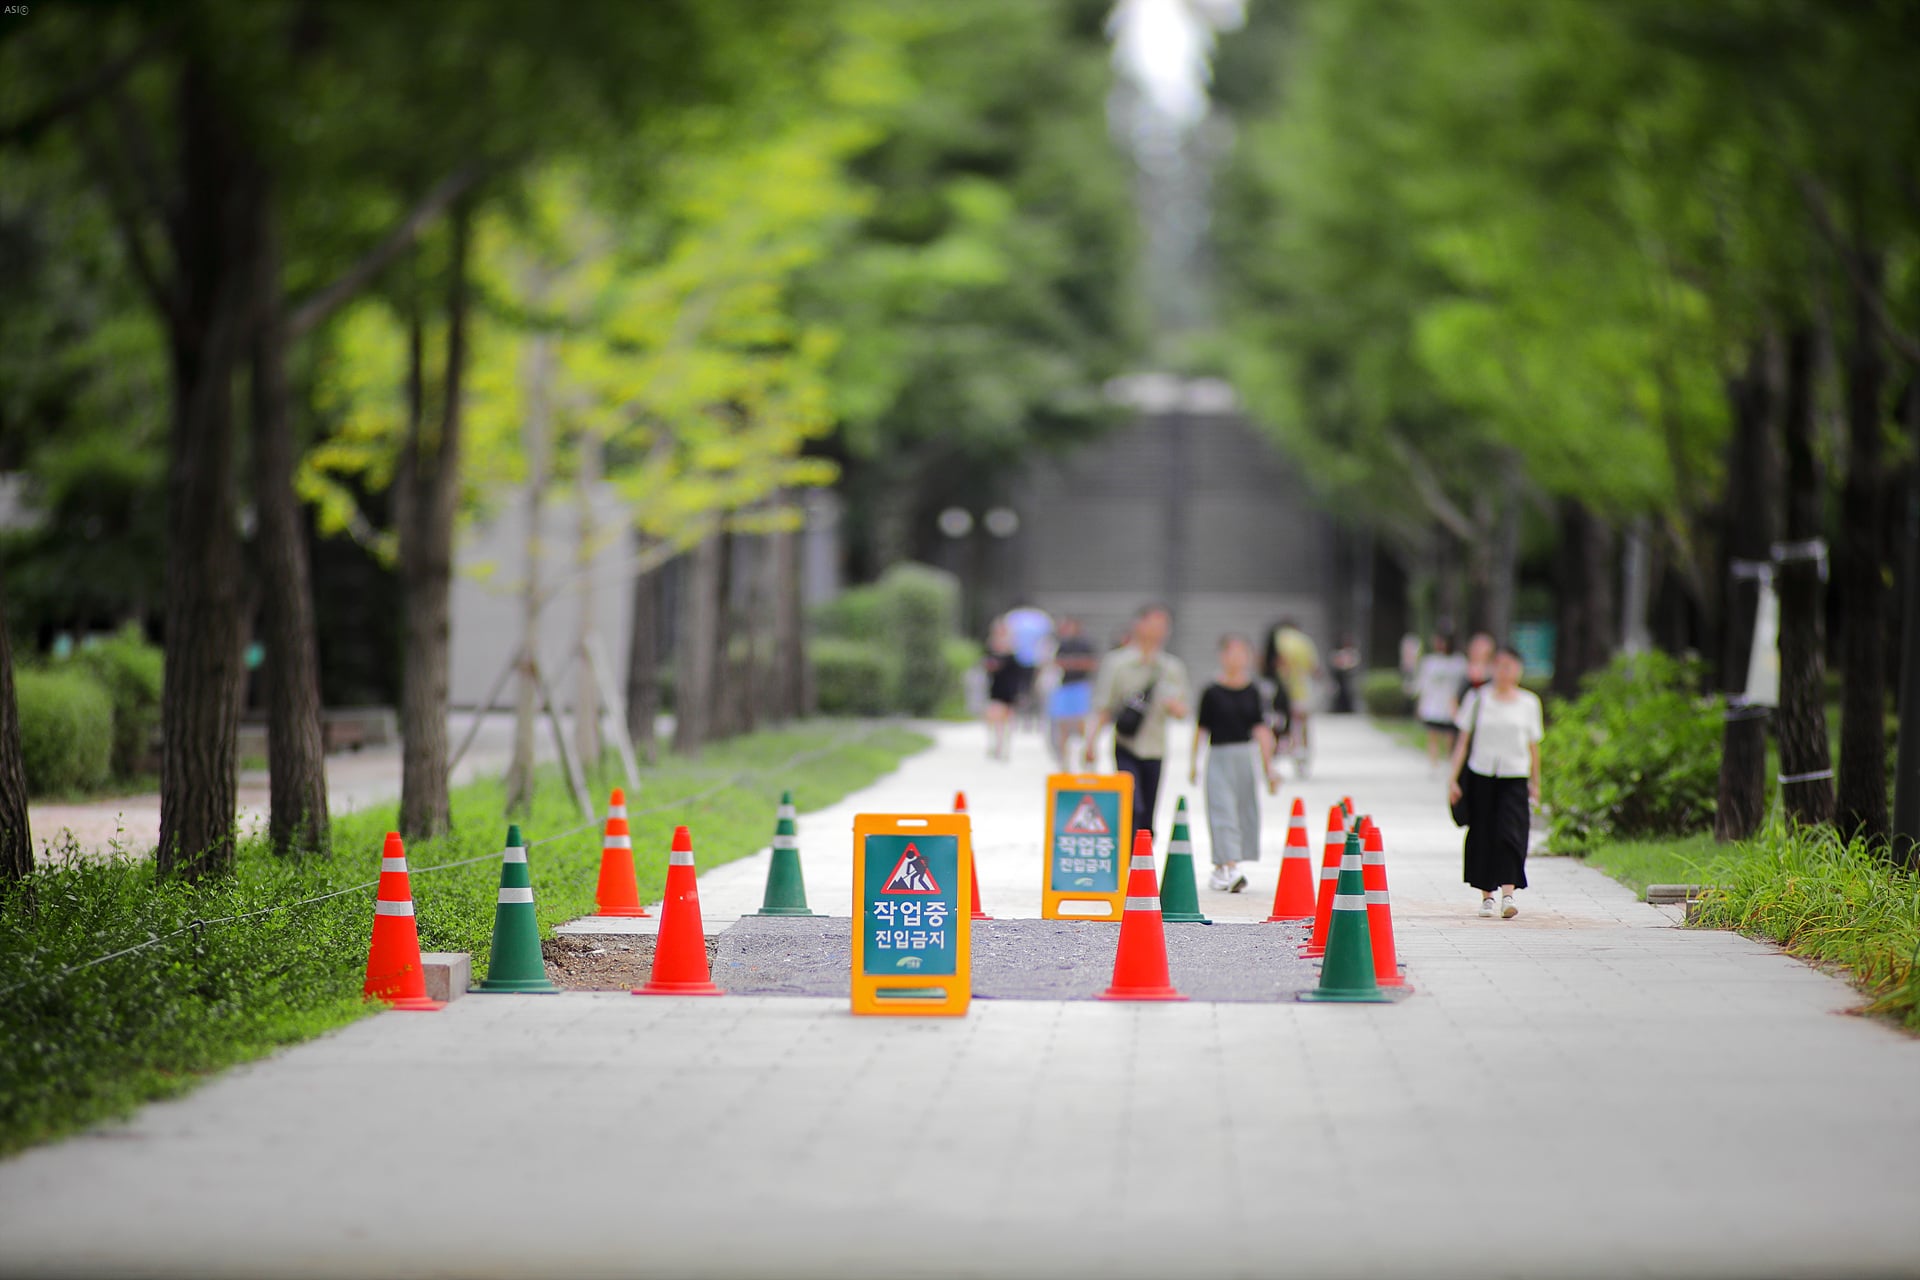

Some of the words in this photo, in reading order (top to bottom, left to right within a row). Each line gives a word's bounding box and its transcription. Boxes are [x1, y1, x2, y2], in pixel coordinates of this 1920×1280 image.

[1058, 836, 1115, 858] 작업중
[1060, 858, 1111, 873] 진입금지
[873, 900, 949, 927] 작업중
[875, 930, 945, 950] 진입금지
